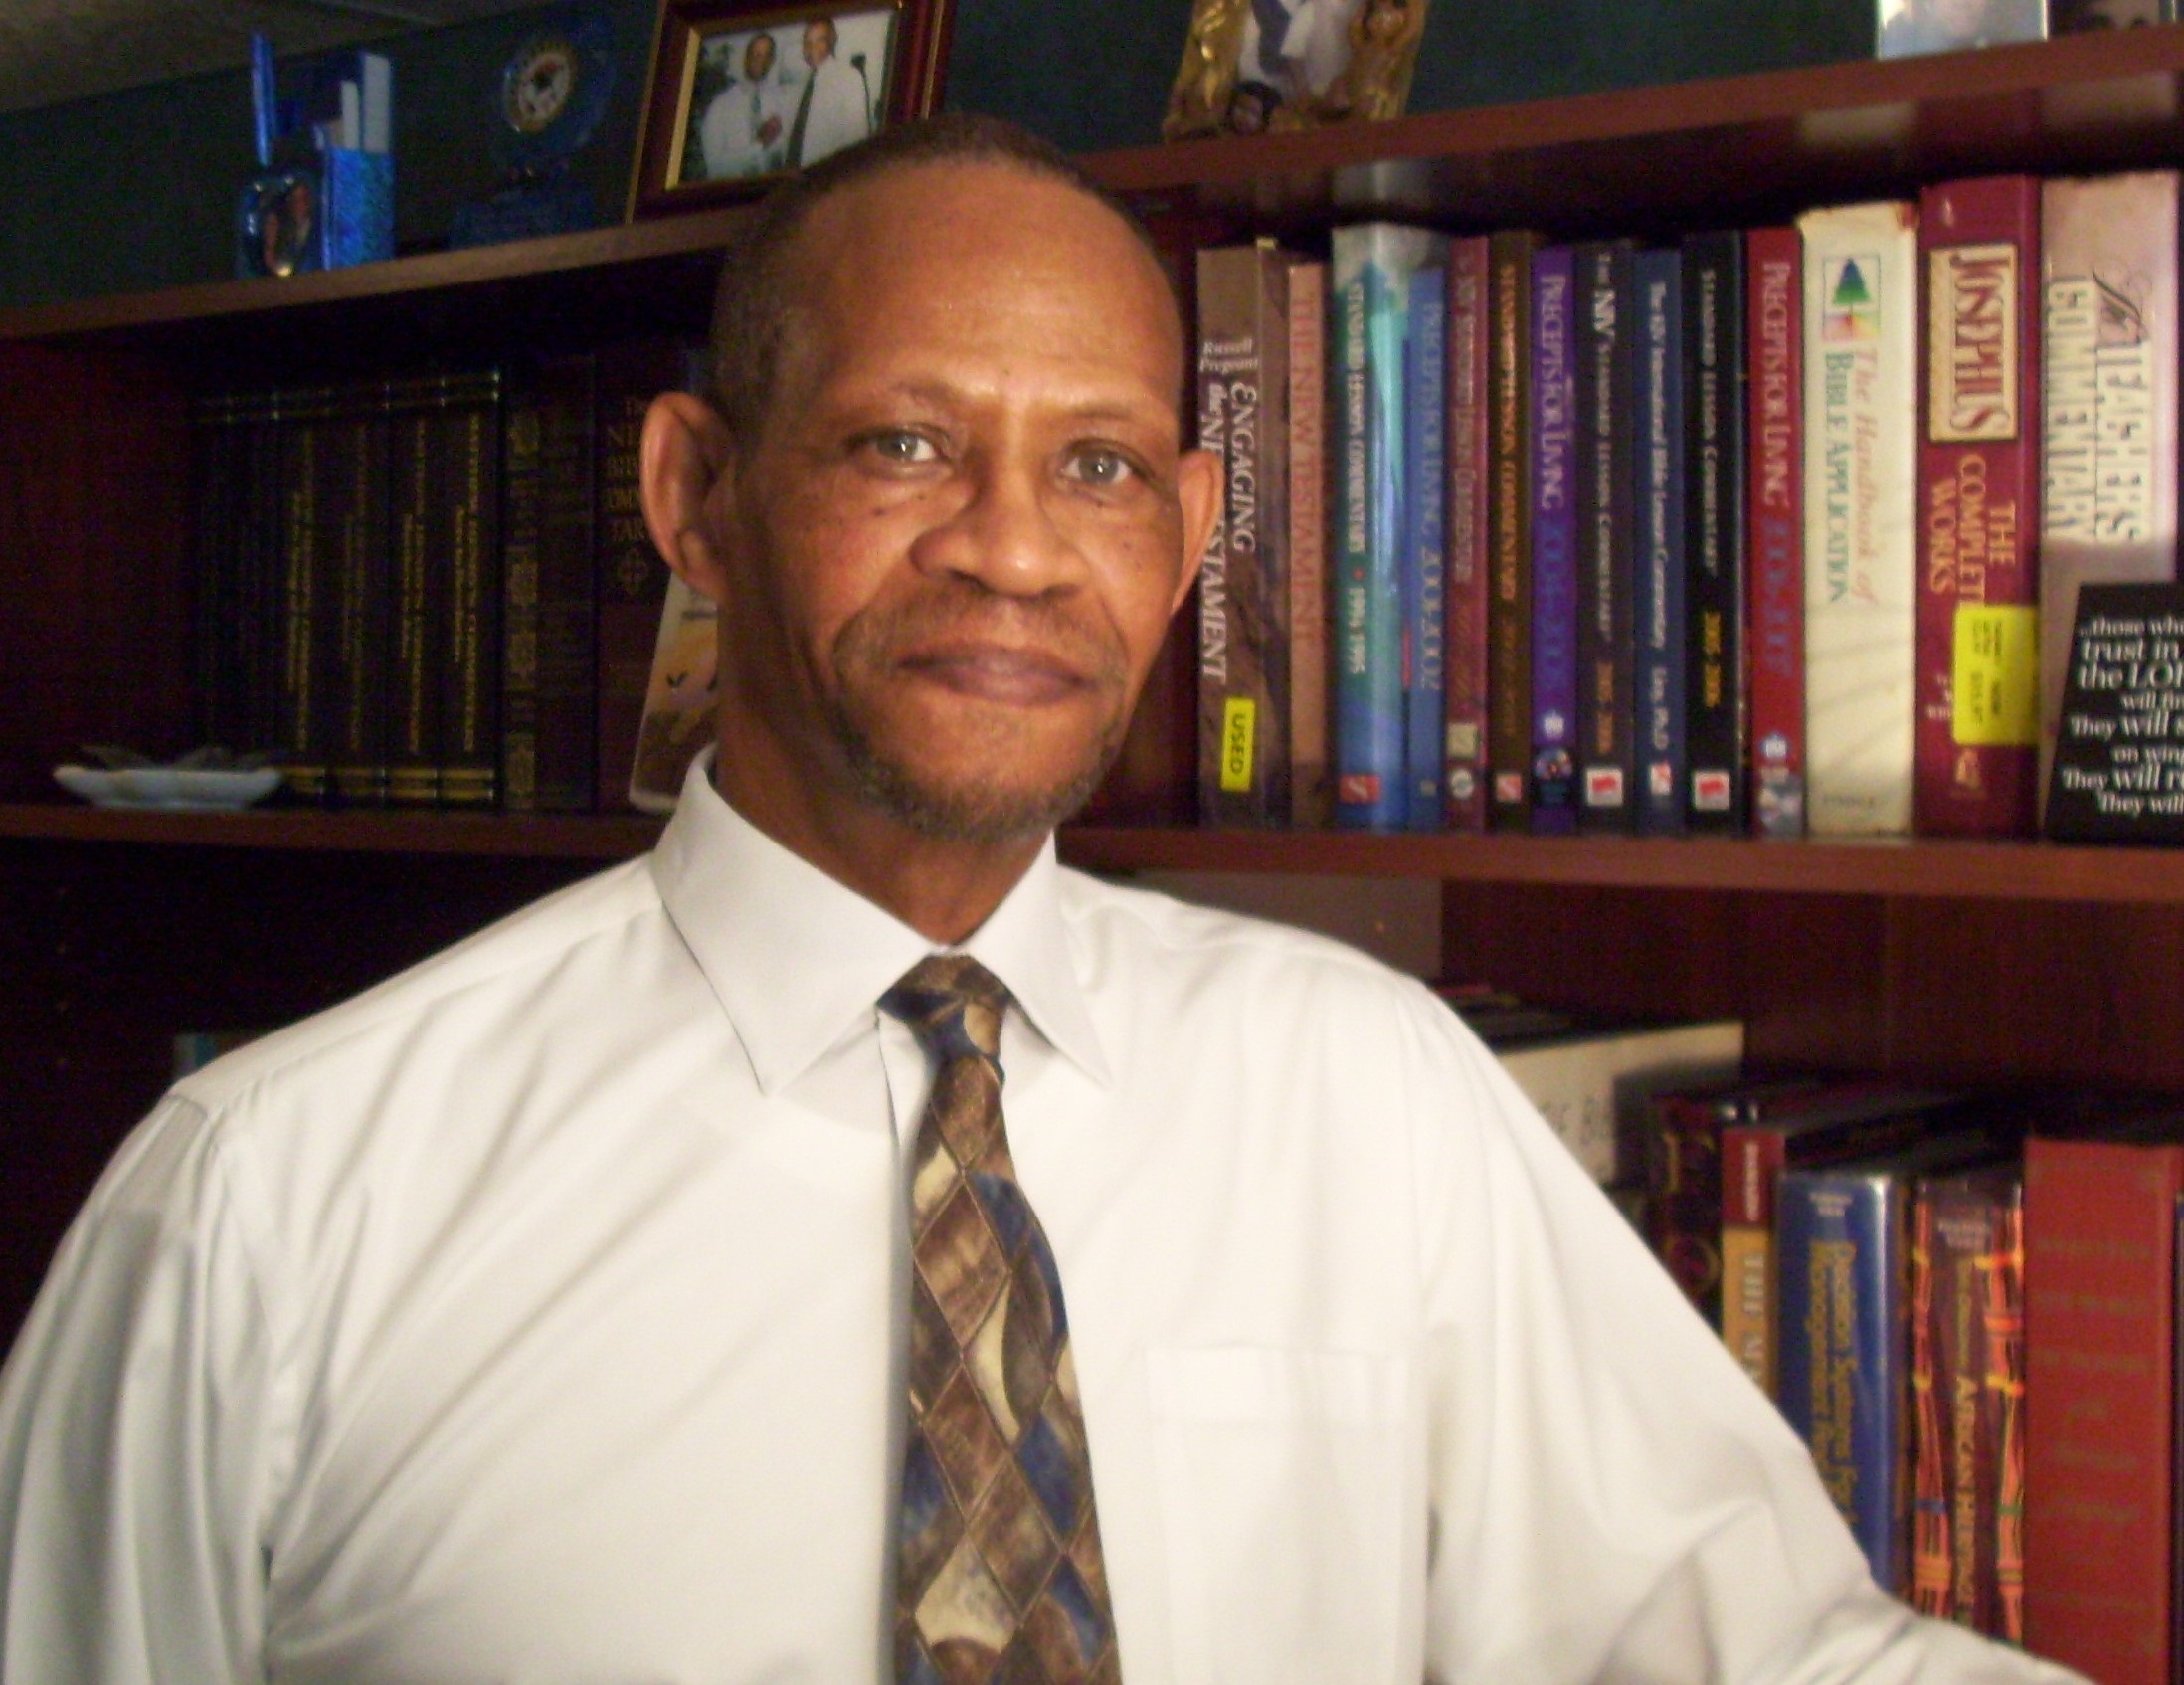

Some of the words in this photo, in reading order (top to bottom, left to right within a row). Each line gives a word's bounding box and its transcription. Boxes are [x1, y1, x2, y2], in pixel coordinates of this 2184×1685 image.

[1540, 275, 1567, 380] PRECEPTS
[1948, 249, 2010, 436] JOSEPHUS
[1293, 367, 1321, 449] NEW
[1542, 383, 1564, 429] FOR
[1763, 373, 1788, 419] FOR
[1824, 351, 1854, 431] BIBLE
[2046, 276, 2095, 543] COMMENTARY
[1229, 382, 1257, 554] ENGAGING
[1541, 431, 1571, 510] LIVING
[1762, 424, 1791, 509] LIVING
[1853, 413, 1880, 567] Handbook
[1293, 460, 1321, 652] TESTAMENT
[1824, 437, 1852, 605] APPLICATION
[1928, 478, 1958, 596] WORKS
[1956, 454, 1988, 607] COMPLET
[1990, 500, 2016, 568] THE
[2078, 661, 2123, 689] the
[2081, 637, 2144, 661] trust
[2154, 637, 2180, 661] in
[1228, 712, 1248, 775] USED
[2070, 714, 2116, 740] They
[2119, 709, 2169, 736] will
[2063, 767, 2108, 793] They
[2113, 763, 2161, 789] will
[2097, 792, 2145, 819] They
